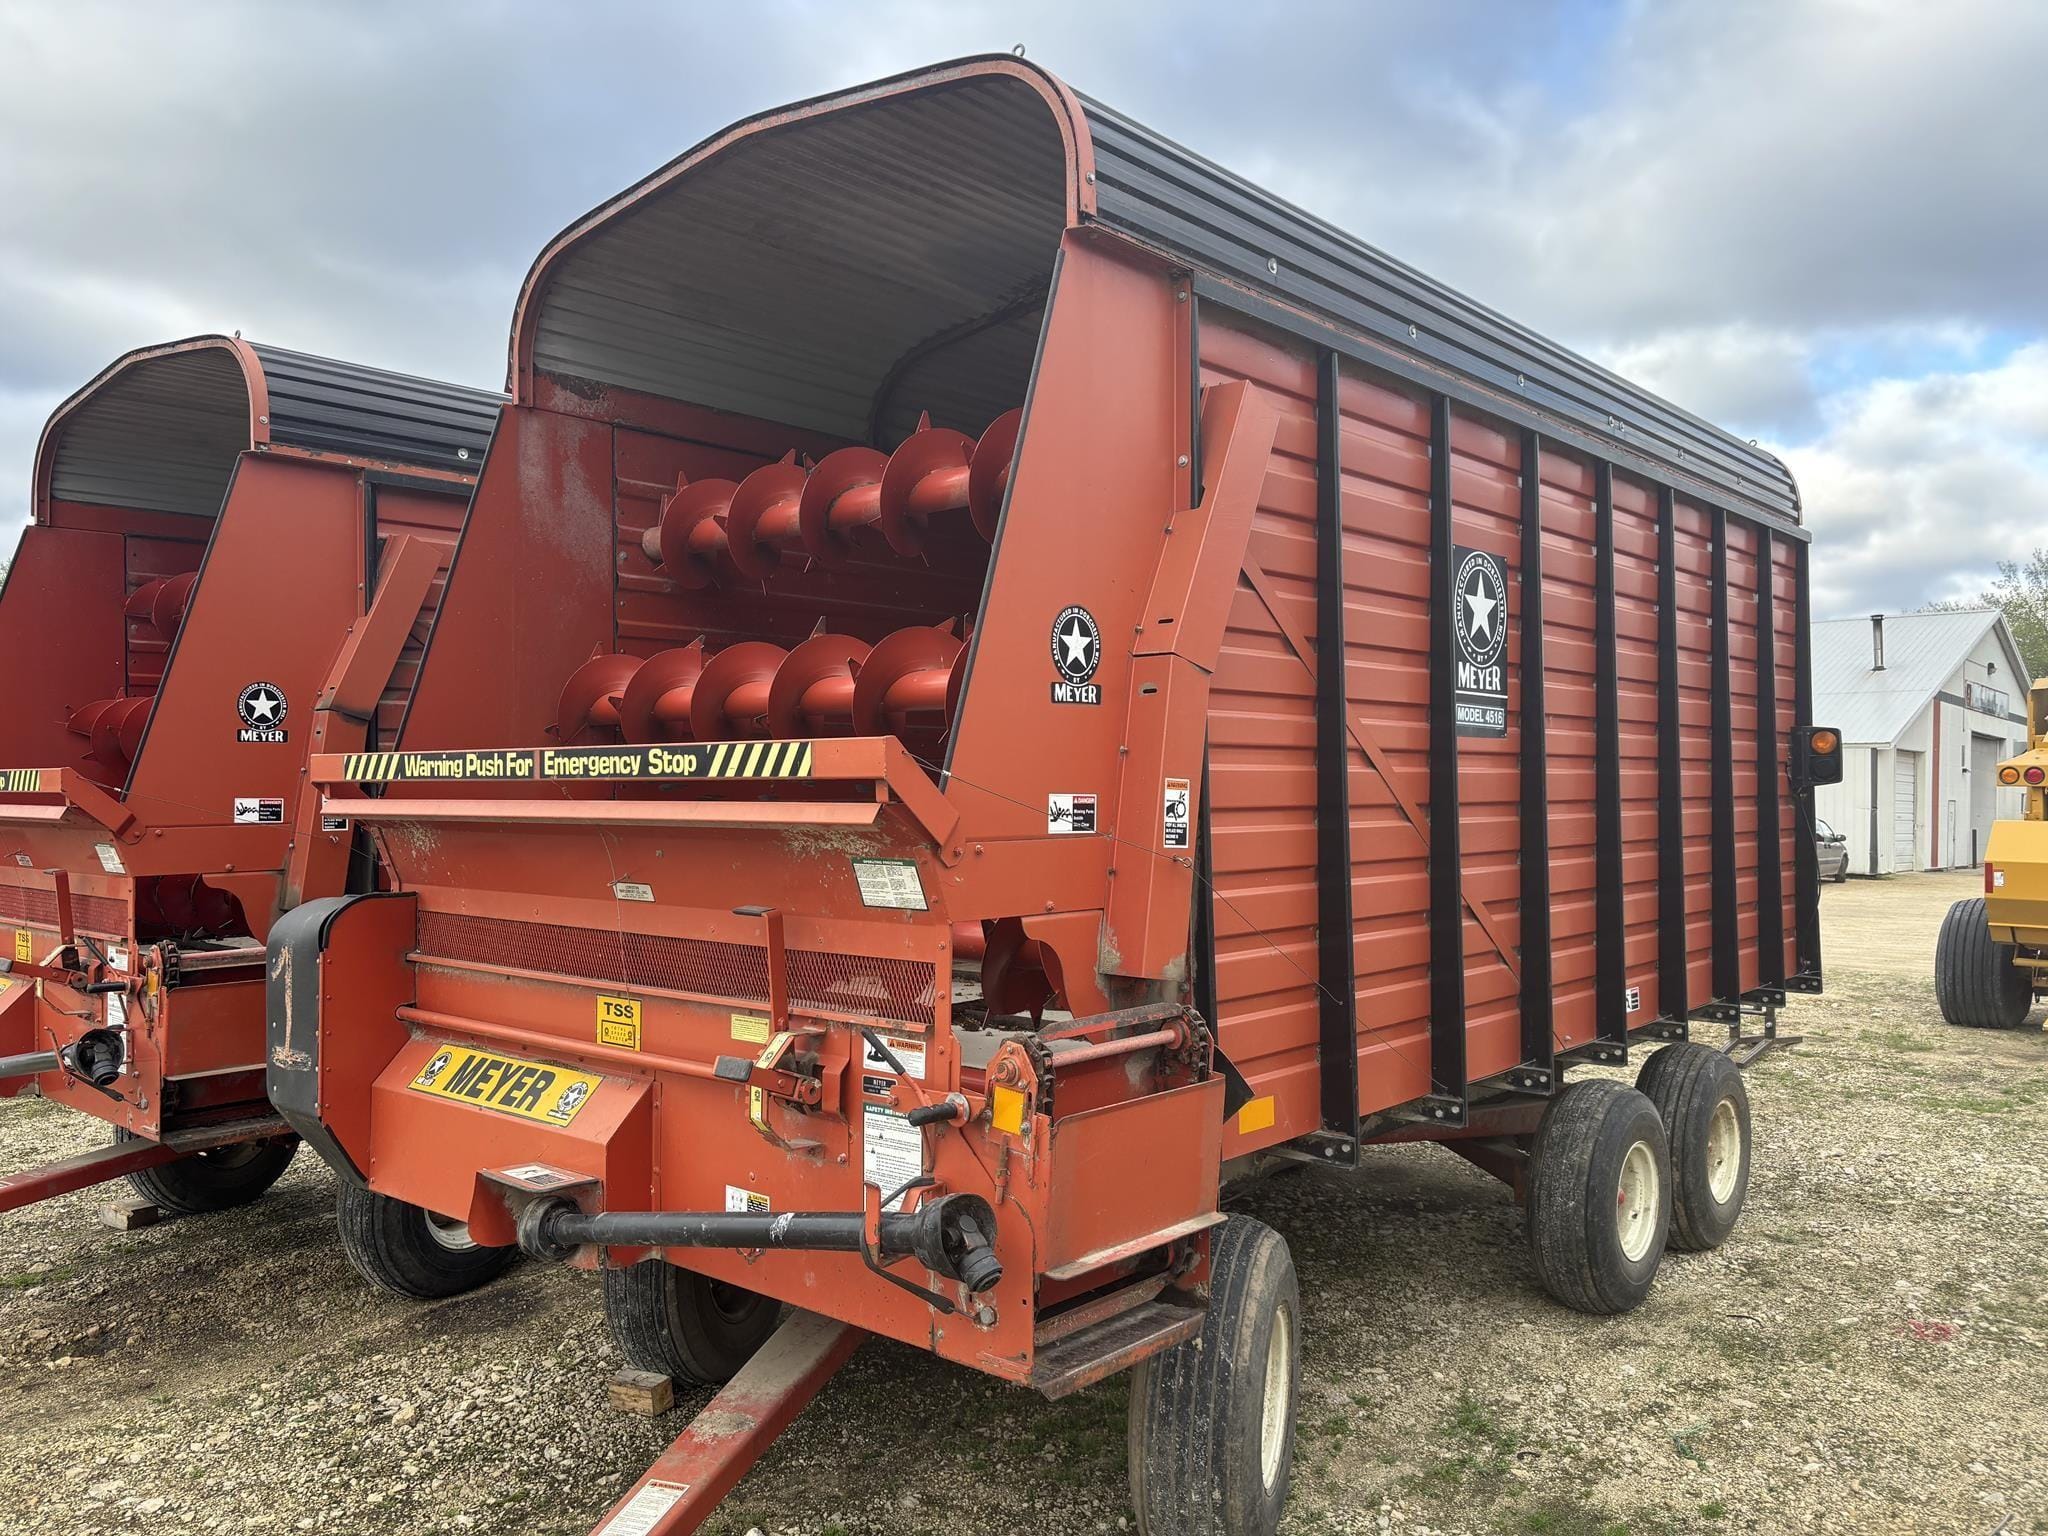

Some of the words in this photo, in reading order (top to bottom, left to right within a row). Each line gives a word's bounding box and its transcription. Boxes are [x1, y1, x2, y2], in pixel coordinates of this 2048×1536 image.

[1458, 661, 1501, 691] MEYER
[1054, 683, 1097, 703] MEYER
[1457, 707, 1484, 722] MODEL
[1485, 710, 1503, 724] 4516
[240, 730, 284, 742] MEYER
[404, 754, 463, 779] Warning
[466, 752, 503, 777] Push
[506, 752, 533, 776] For
[544, 750, 641, 776] Emergency
[648, 748, 697, 776] Stop
[18, 933, 29, 943] TSS
[604, 1002, 634, 1019] TSS
[897, 1042, 922, 1051] WARNING
[442, 1055, 556, 1112] MEYER
[866, 1105, 884, 1113] SAFETY
